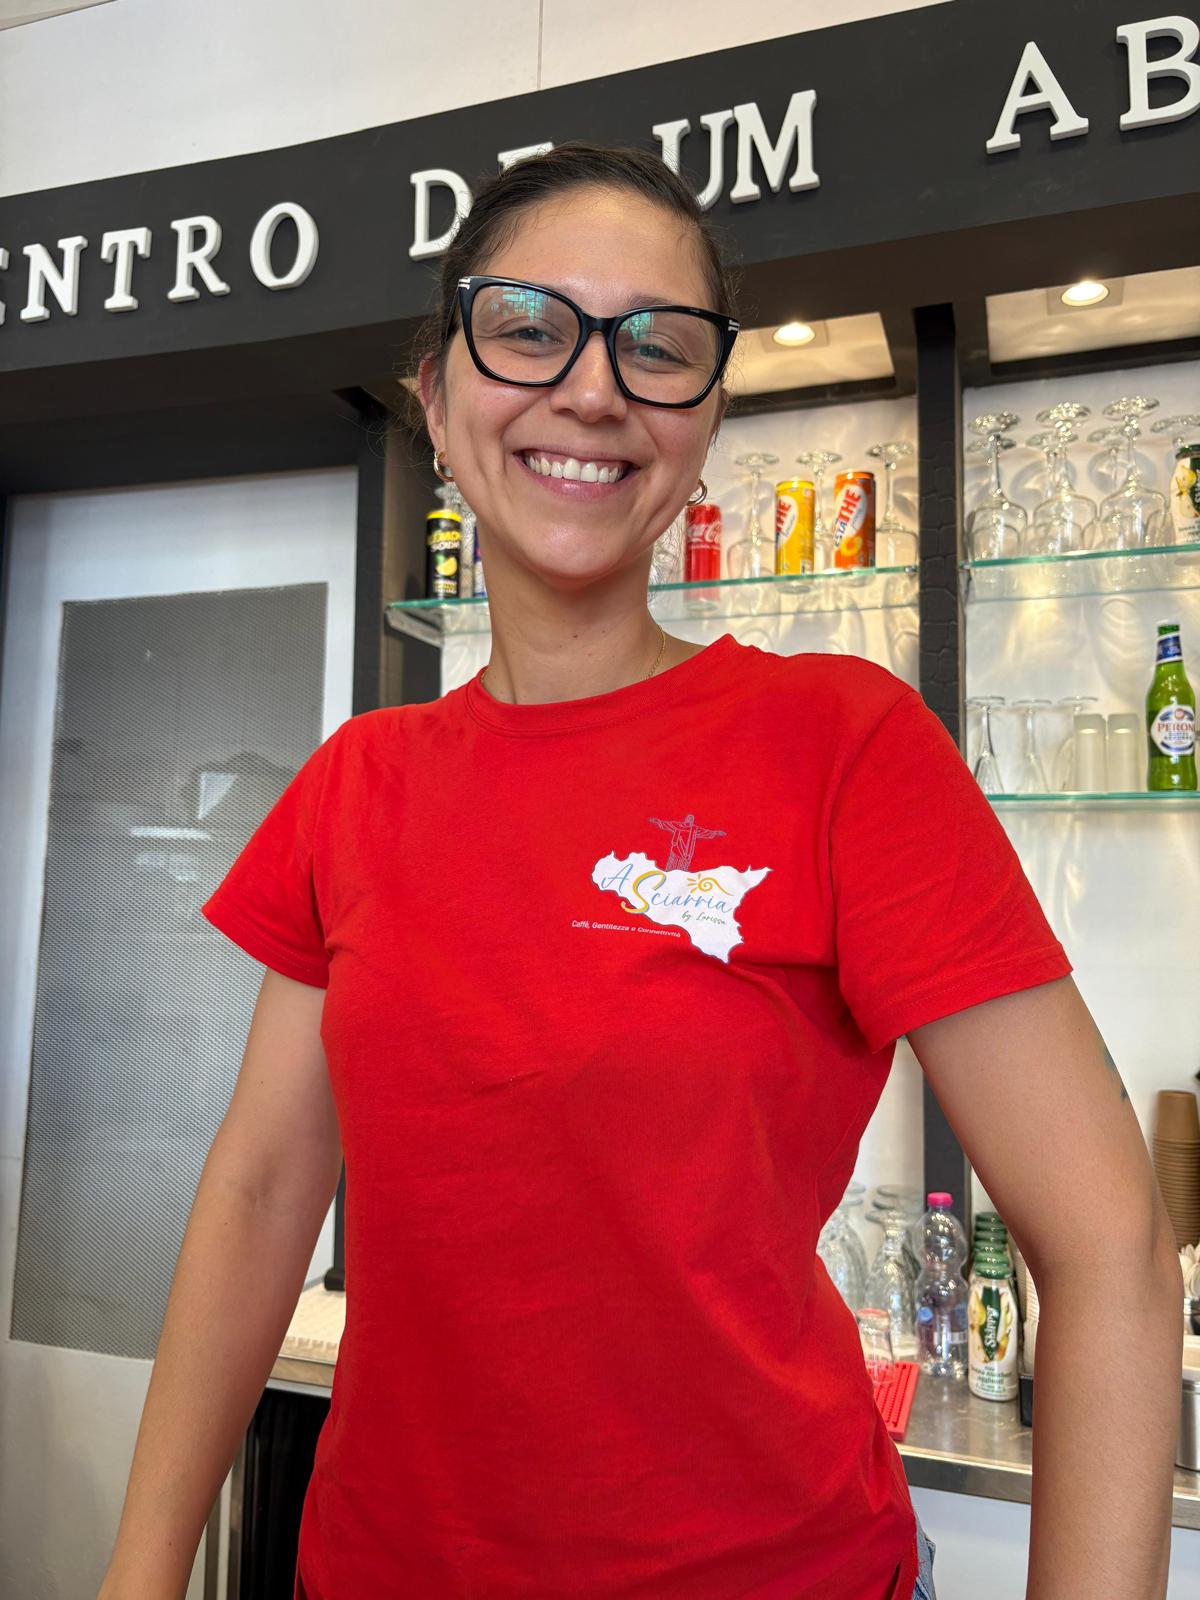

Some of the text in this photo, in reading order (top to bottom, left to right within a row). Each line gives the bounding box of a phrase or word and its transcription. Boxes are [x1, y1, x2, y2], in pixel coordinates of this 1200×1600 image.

[0, 15, 1200, 325] NTRO D UM AB
[1157, 722, 1195, 732] PERON
[601, 863, 733, 914] A Sciarria
[681, 910, 692, 922] by
